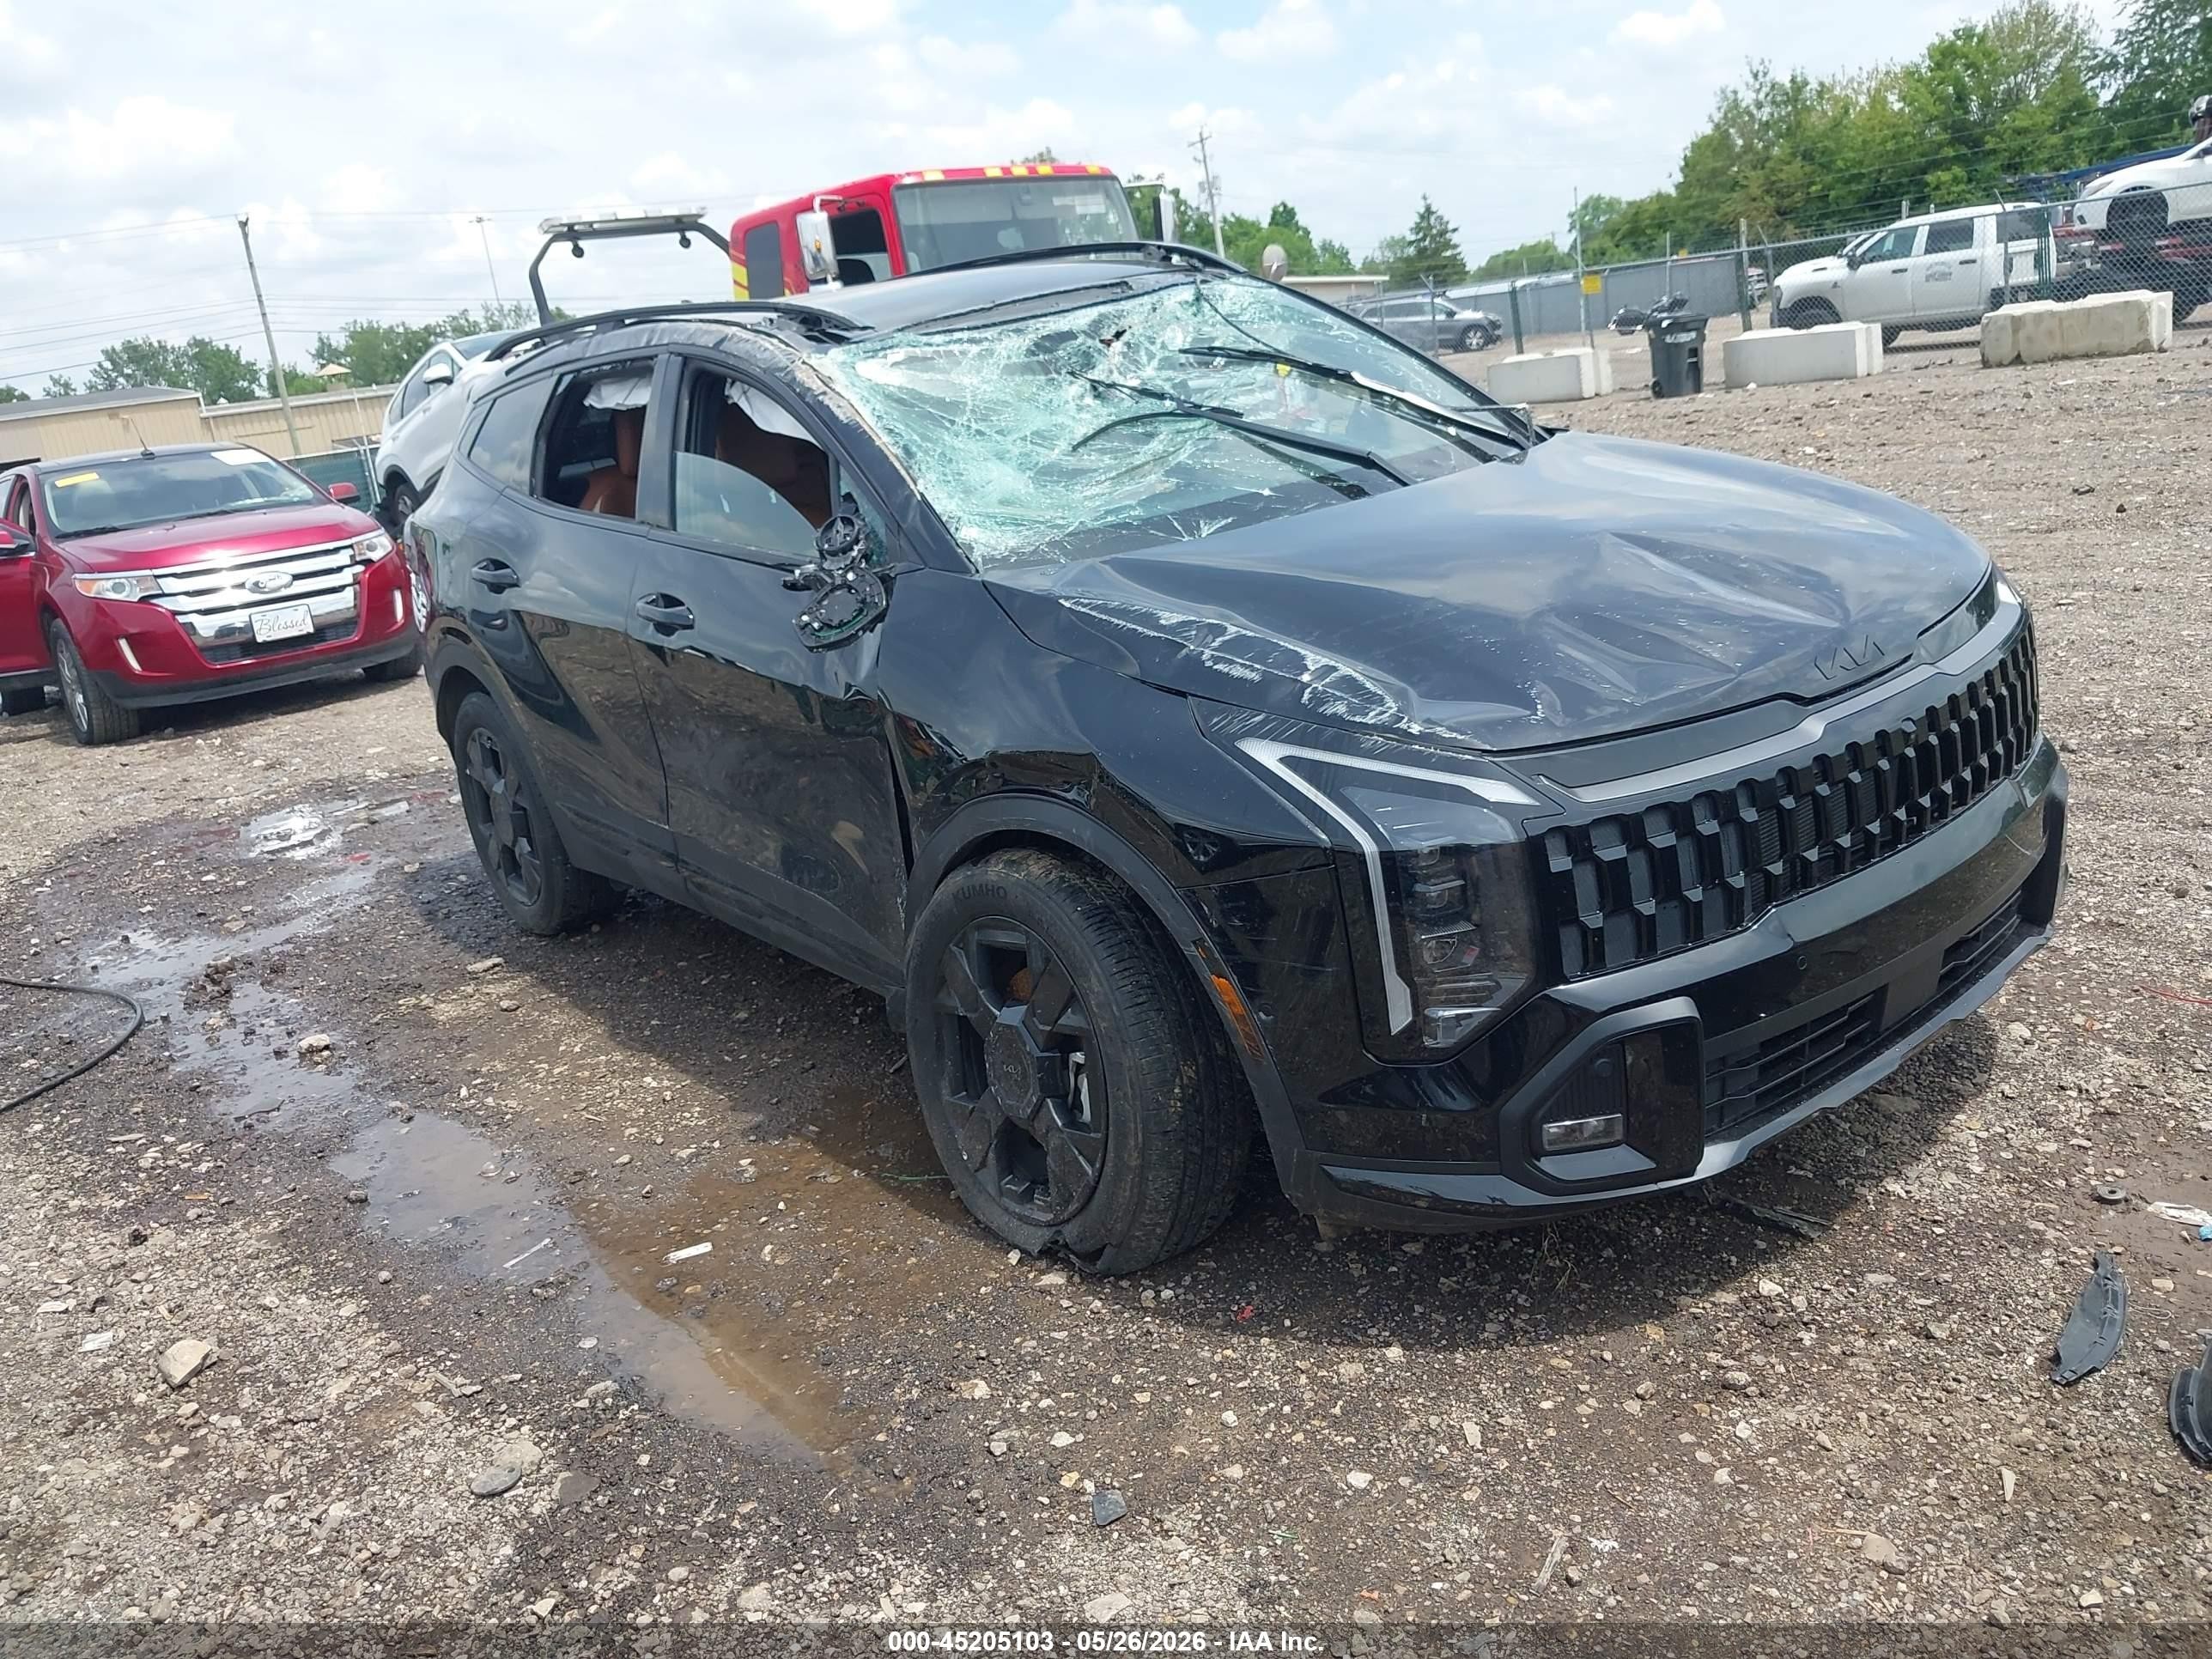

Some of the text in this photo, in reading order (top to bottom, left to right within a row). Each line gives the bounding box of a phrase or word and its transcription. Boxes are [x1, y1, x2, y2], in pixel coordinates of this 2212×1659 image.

[254, 610, 308, 636] Blessed
[1814, 635, 1886, 681] KIA
[951, 882, 1007, 902] KUMHO
